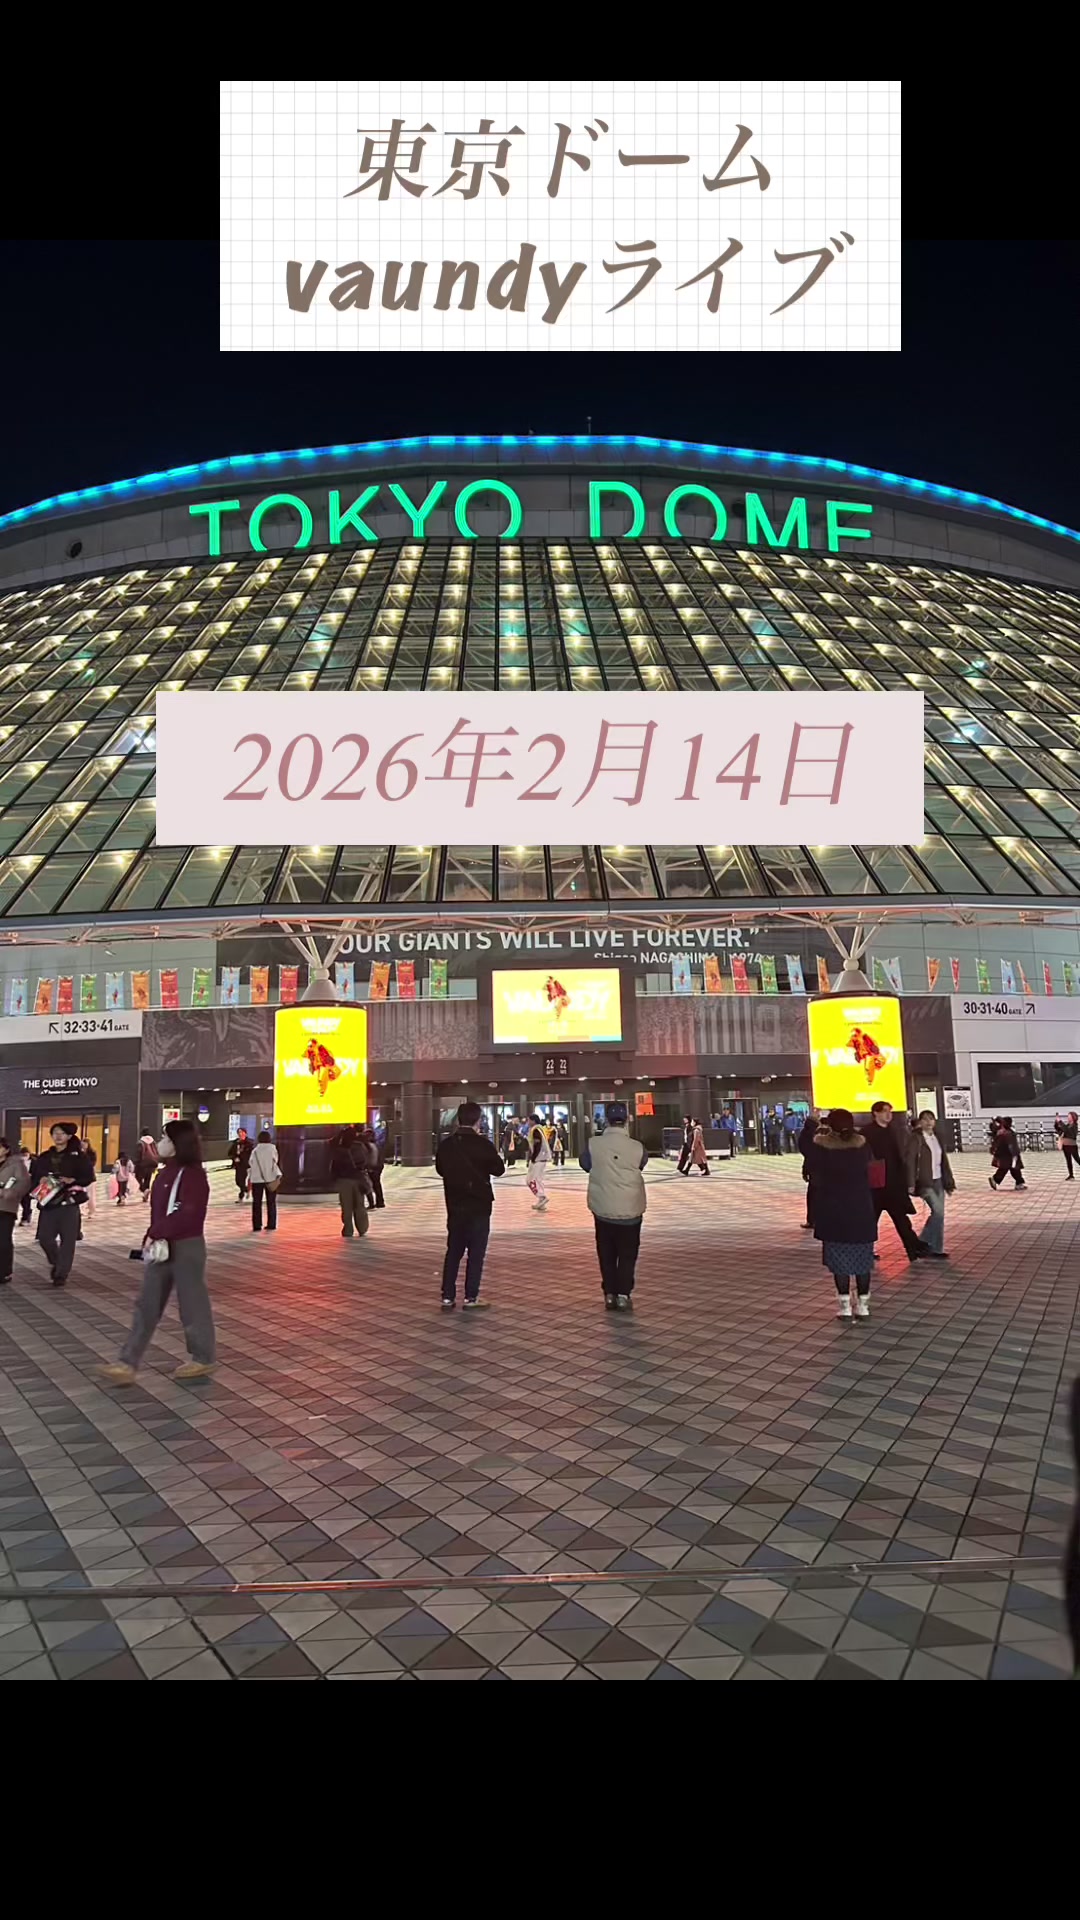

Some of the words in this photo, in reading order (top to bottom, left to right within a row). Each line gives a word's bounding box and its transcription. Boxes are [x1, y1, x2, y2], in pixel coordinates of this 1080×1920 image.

[188, 478, 523, 557] TOKYO
[589, 480, 873, 553] DOME
[569, 930, 625, 948] LIVE
[546, 1059, 554, 1069] 22
[560, 1059, 567, 1069] 22
[23, 1079, 40, 1088] THE
[42, 1078, 66, 1088] CUBE
[67, 1077, 98, 1087] TOKYO
